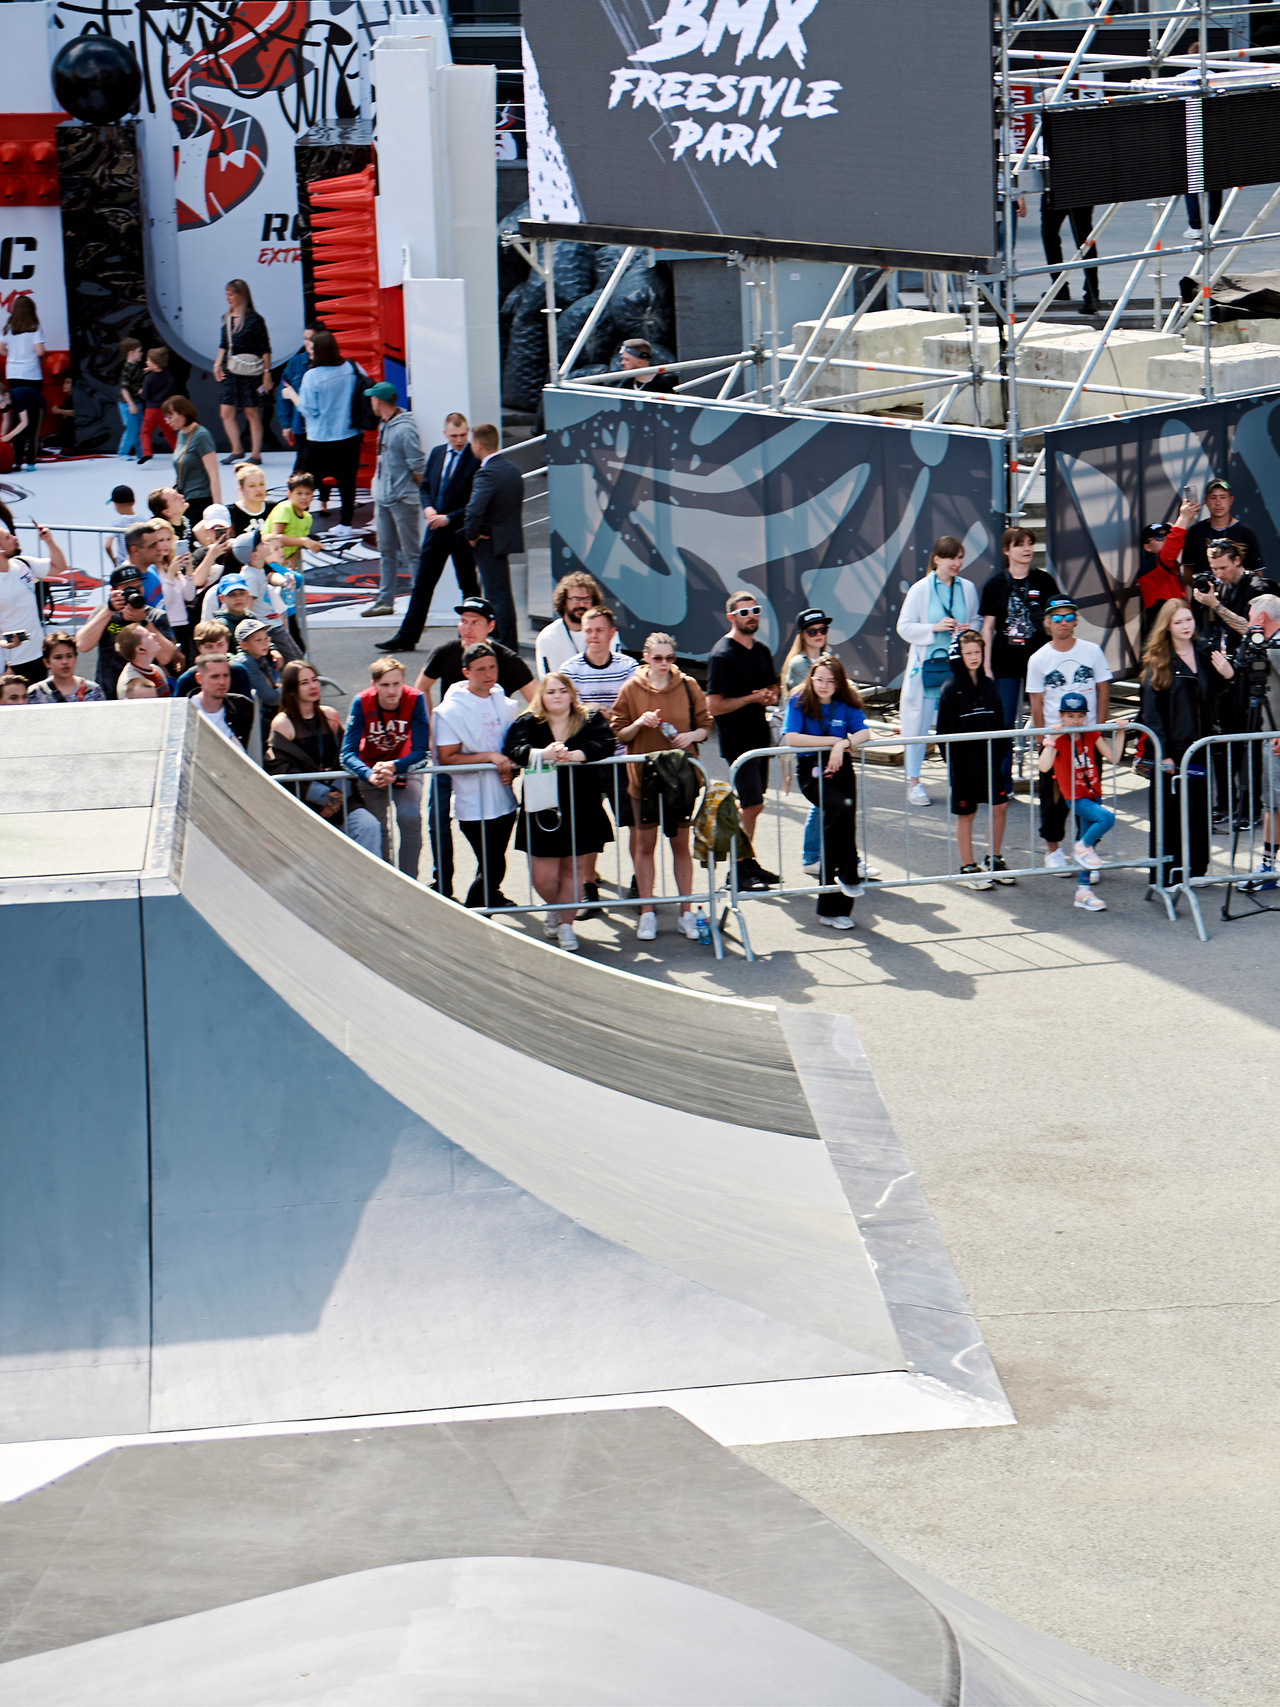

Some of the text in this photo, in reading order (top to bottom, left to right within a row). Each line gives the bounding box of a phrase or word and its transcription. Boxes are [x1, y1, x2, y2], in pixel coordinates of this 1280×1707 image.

[627, 0, 818, 70] BMX
[608, 67, 843, 120] FREESTYLE
[669, 117, 783, 169] PARK
